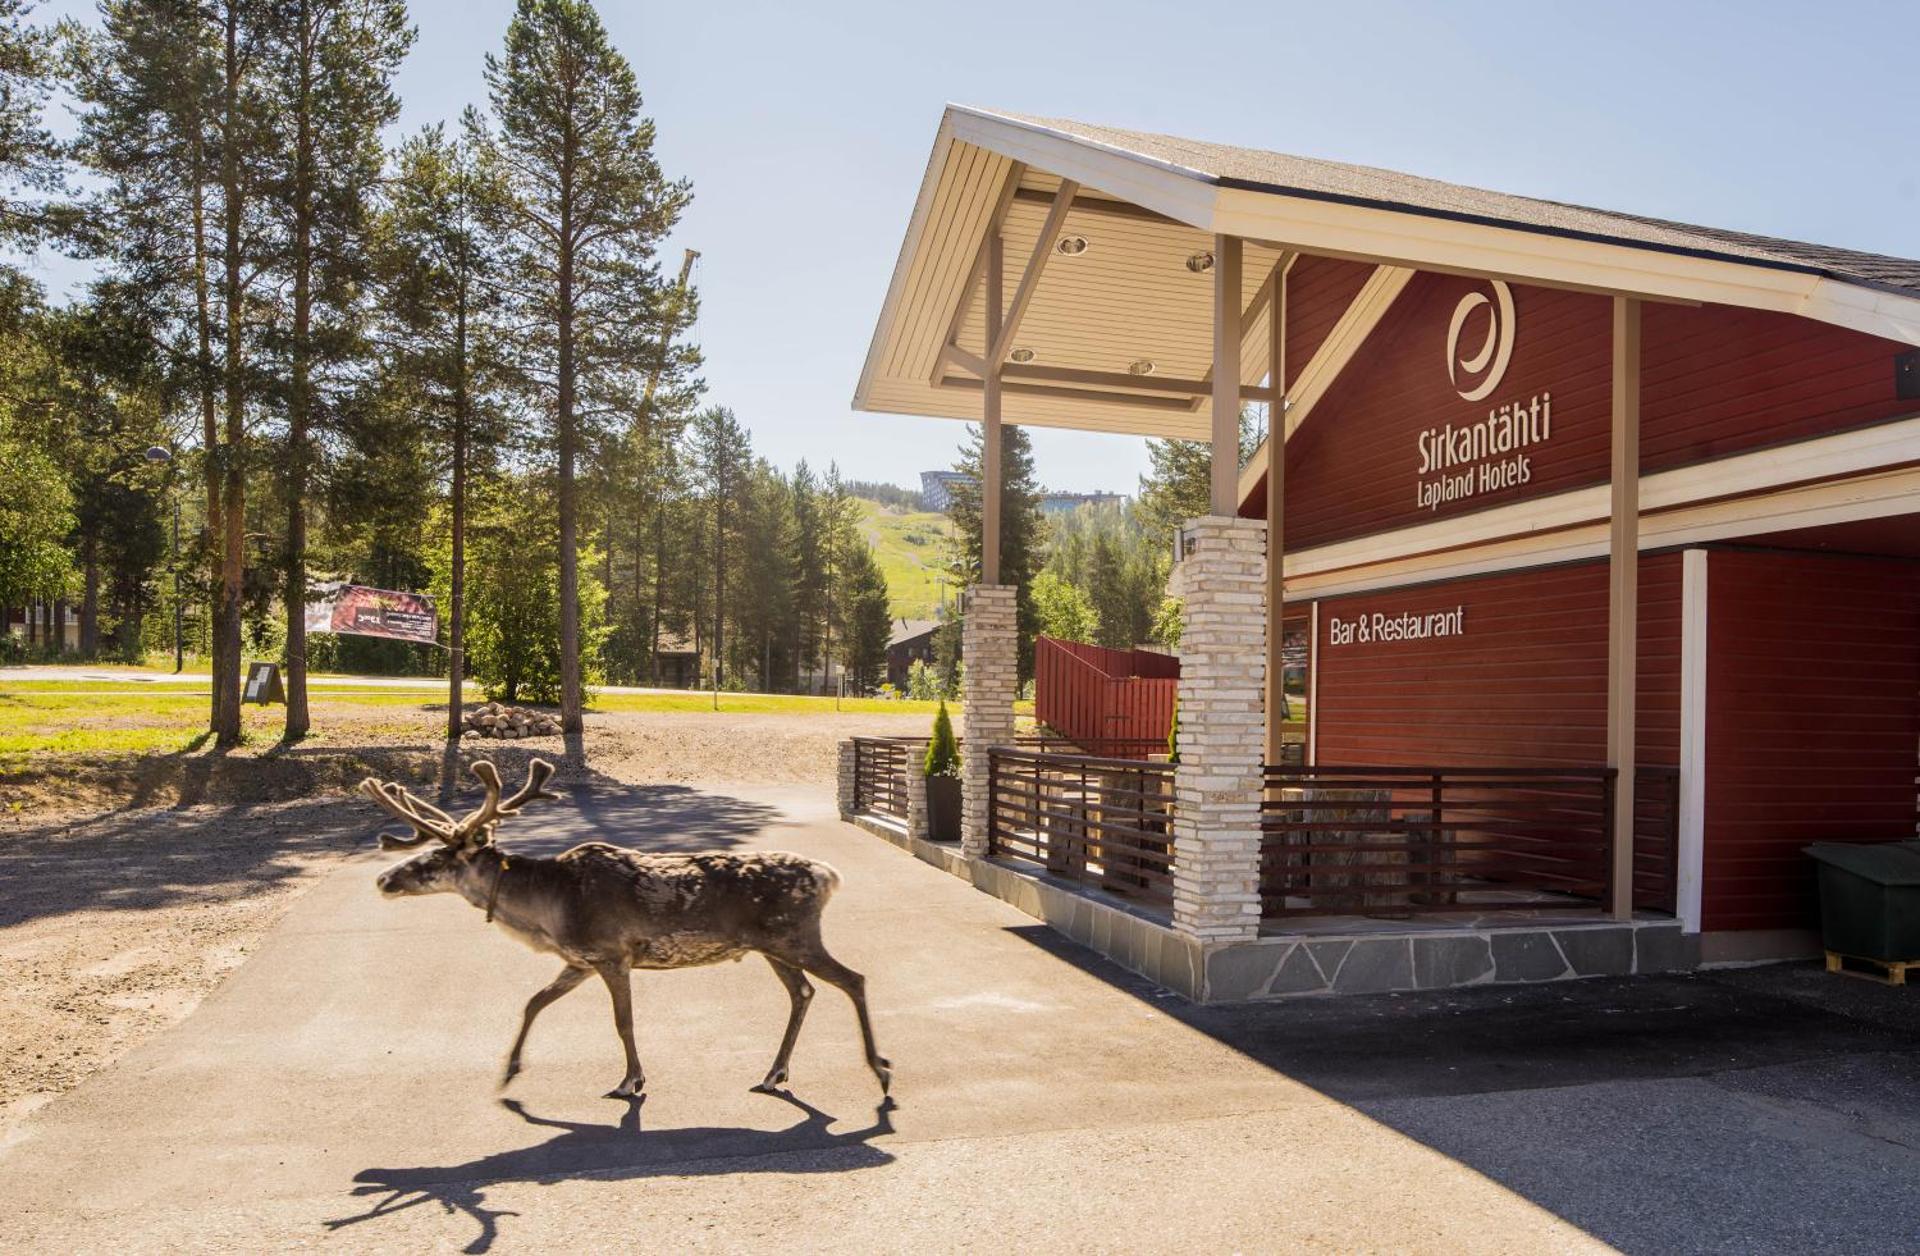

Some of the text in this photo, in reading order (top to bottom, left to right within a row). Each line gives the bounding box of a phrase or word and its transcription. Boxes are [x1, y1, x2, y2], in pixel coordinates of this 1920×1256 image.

[1418, 392, 1550, 474] Sirkantähti
[1417, 454, 1531, 511] Lapland Hotels
[1330, 618, 1357, 645] Bar
[1372, 605, 1463, 642] Restaurant
